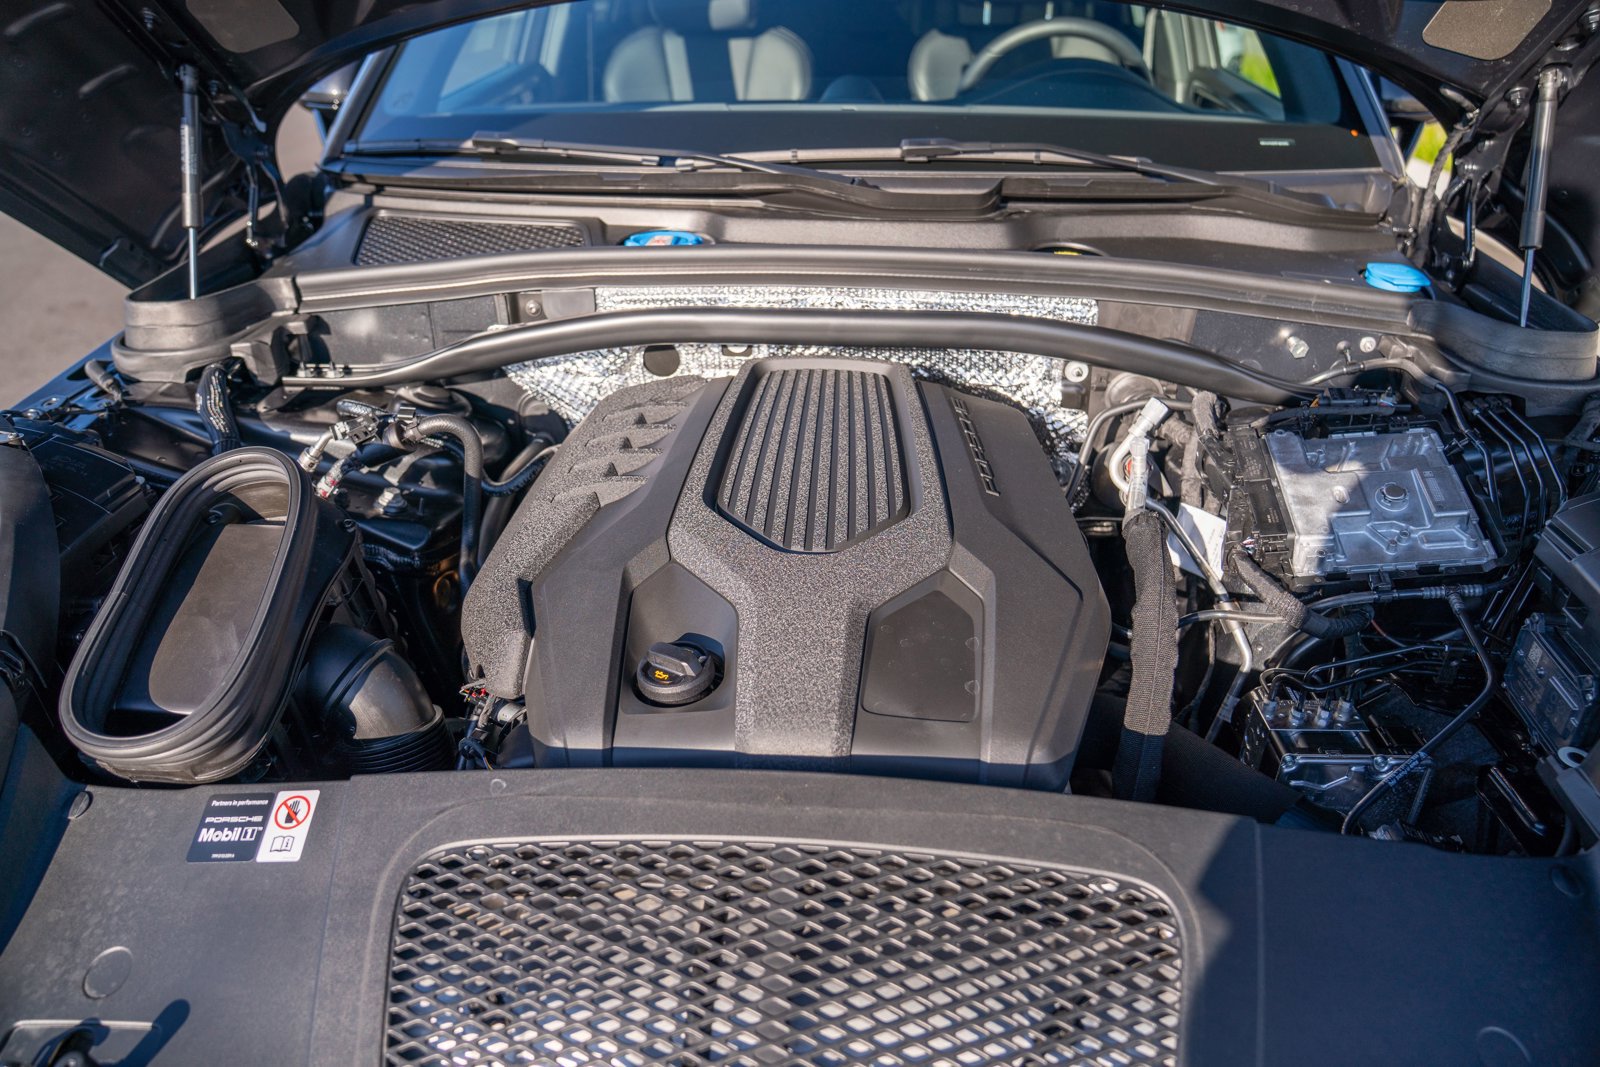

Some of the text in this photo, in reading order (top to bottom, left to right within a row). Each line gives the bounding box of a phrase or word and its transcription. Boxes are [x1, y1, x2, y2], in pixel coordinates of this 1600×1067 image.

[951, 396, 1000, 497] PORSCHE
[237, 799, 269, 807] performance
[205, 815, 263, 823] PORSCHE
[198, 828, 241, 842] Mobil
